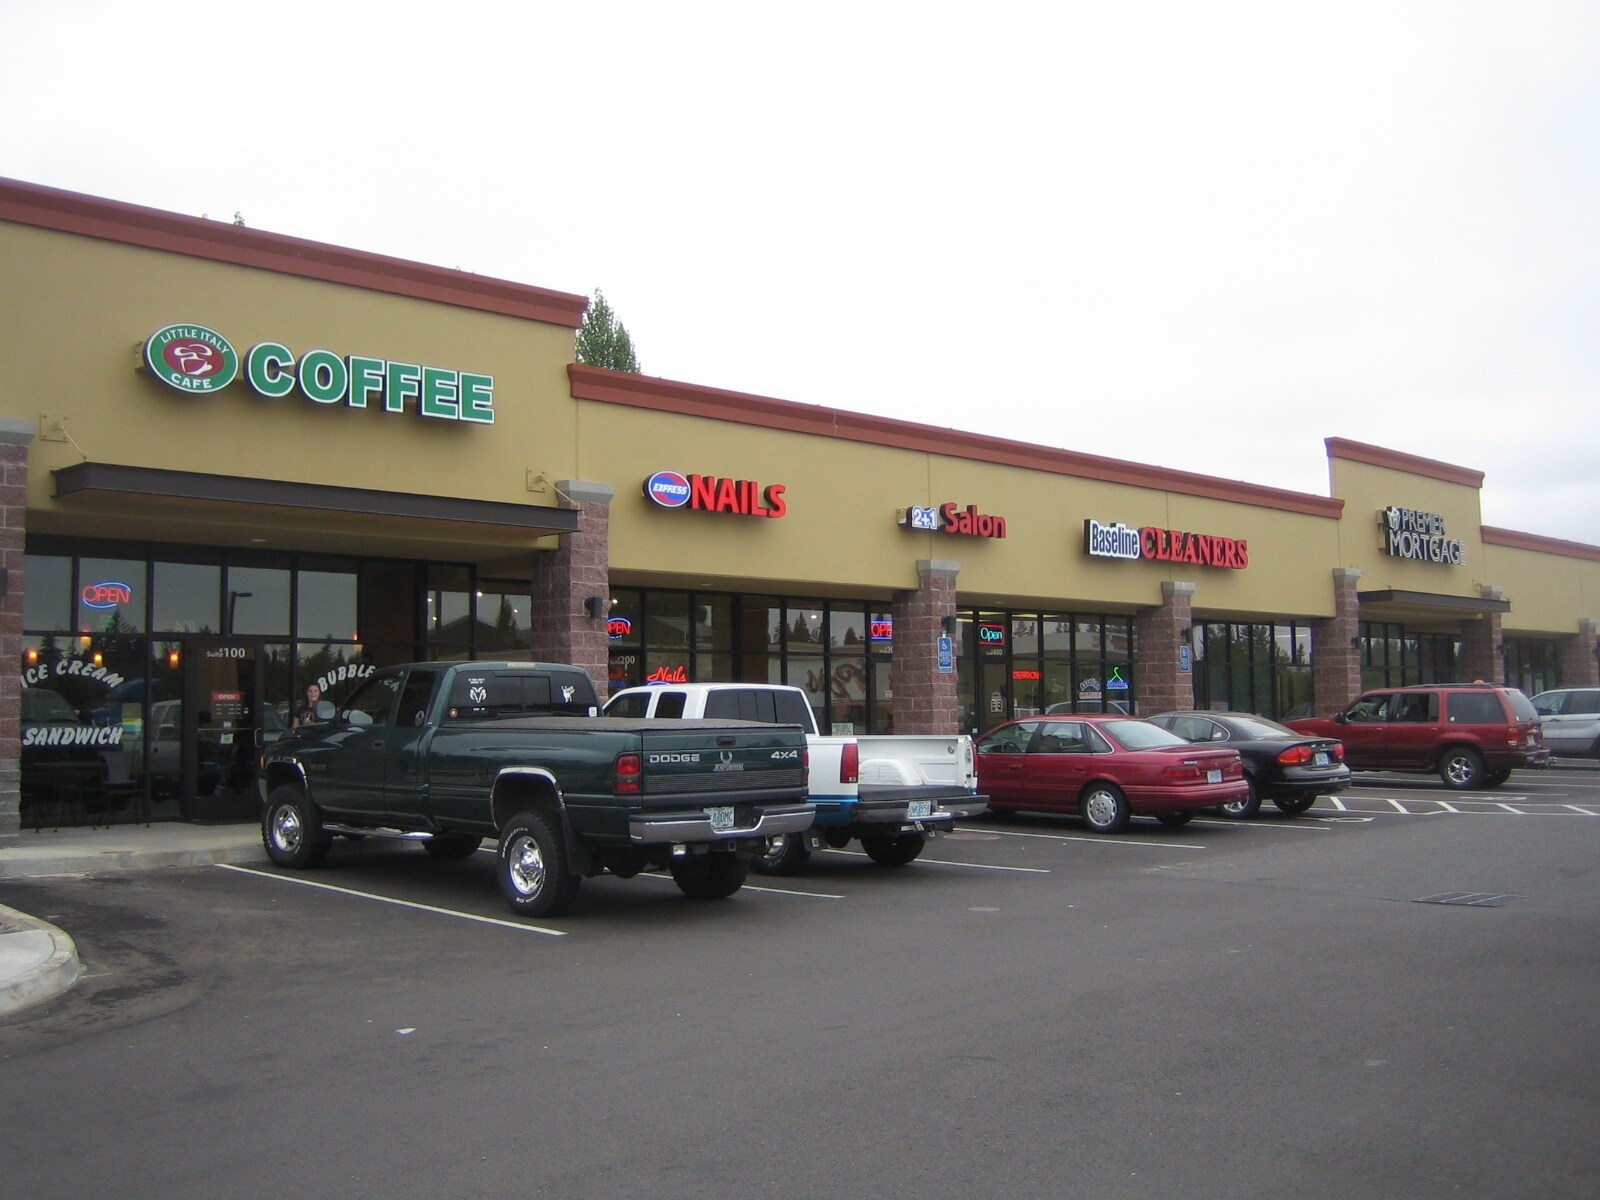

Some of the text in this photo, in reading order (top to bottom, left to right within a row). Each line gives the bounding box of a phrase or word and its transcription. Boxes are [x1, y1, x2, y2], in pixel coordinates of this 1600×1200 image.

[160, 328, 229, 354] LITTLE ITALY
[170, 372, 212, 389] CAFE
[246, 341, 495, 424] COFFEE
[688, 474, 787, 519] NAILS
[911, 502, 1006, 538] 2+1 Salon
[1091, 521, 1249, 569] Baseline CLEANERS
[82, 586, 130, 604] OPEN
[872, 623, 893, 638] OPE
[980, 627, 1003, 642] Open
[20, 659, 125, 688] ICE CREAM
[317, 663, 376, 692] BUBBLE
[647, 666, 687, 682] Nails
[23, 727, 123, 746] SANDWICH
[650, 753, 700, 763] DODGE
